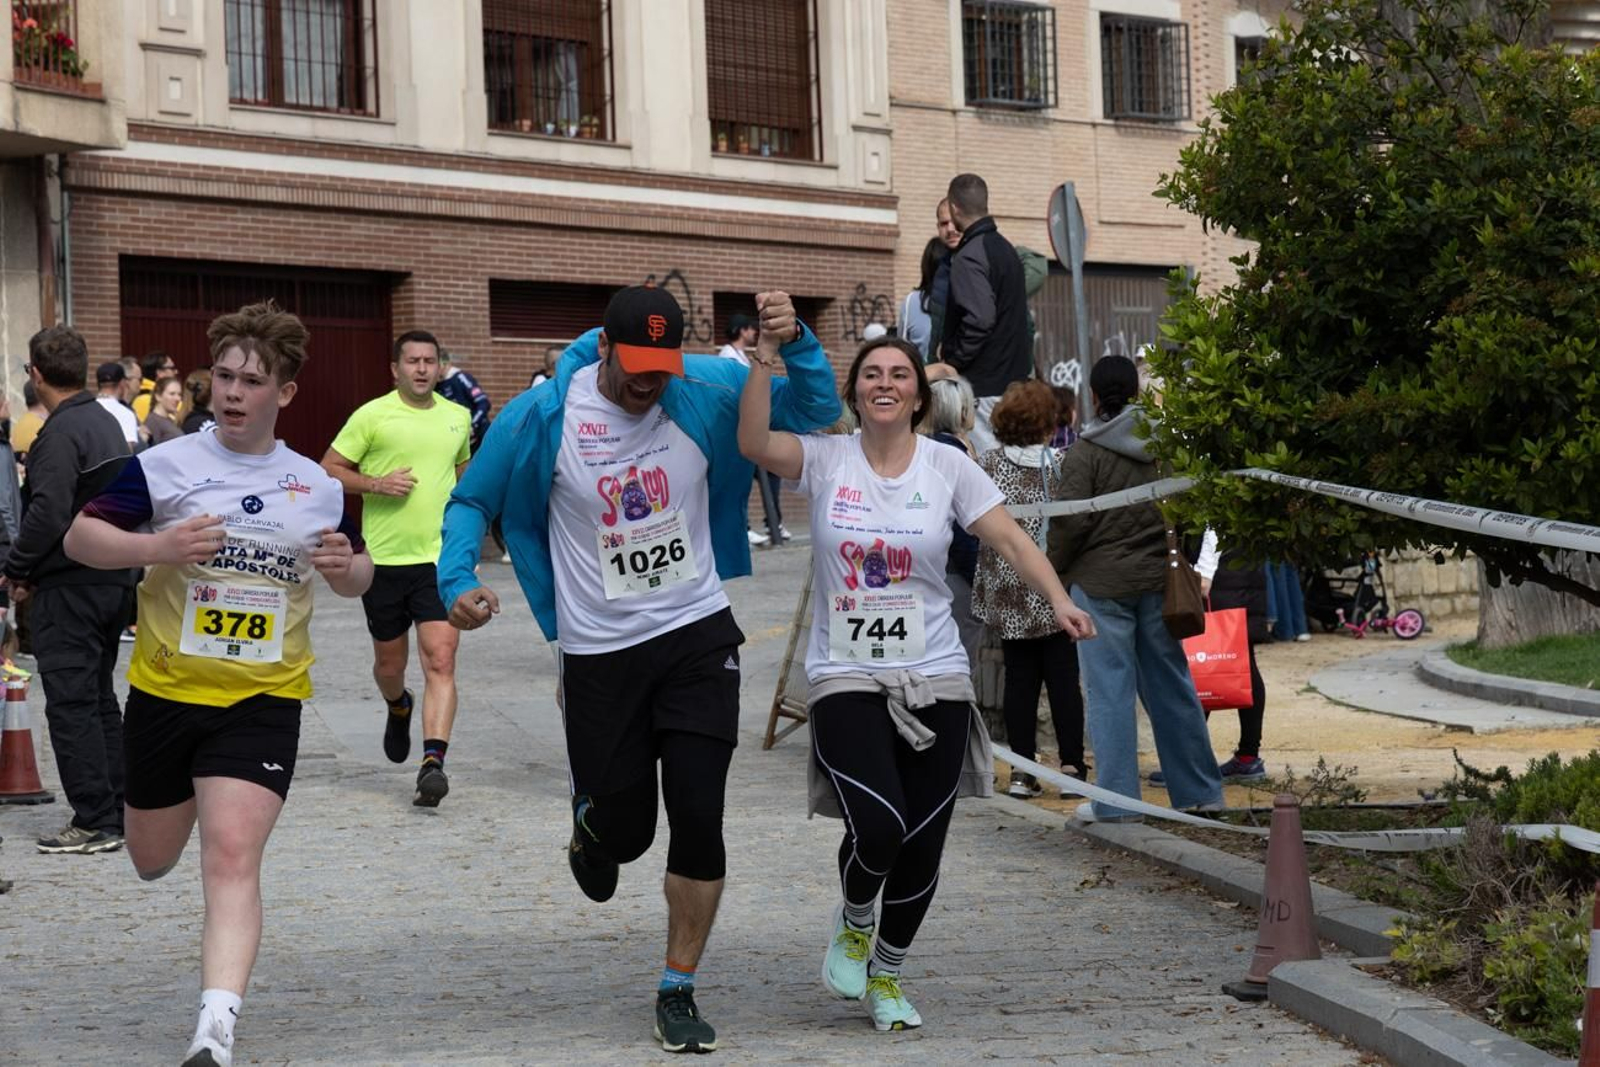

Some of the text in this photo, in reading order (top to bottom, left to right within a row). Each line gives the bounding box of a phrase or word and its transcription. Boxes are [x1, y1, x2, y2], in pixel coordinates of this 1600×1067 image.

[578, 423, 608, 436] XXVII
[836, 485, 861, 502] XXVII
[217, 513, 242, 525] PABLO
[244, 518, 285, 530] CARVAJAL
[216, 546, 248, 558] NTA
[277, 555, 296, 569] DE
[228, 537, 244, 547] DE
[249, 540, 301, 559] RUNNING
[610, 538, 686, 576] 1026
[203, 609, 267, 640] 378
[847, 616, 908, 641] 744
[1207, 653, 1238, 661] MORENO
